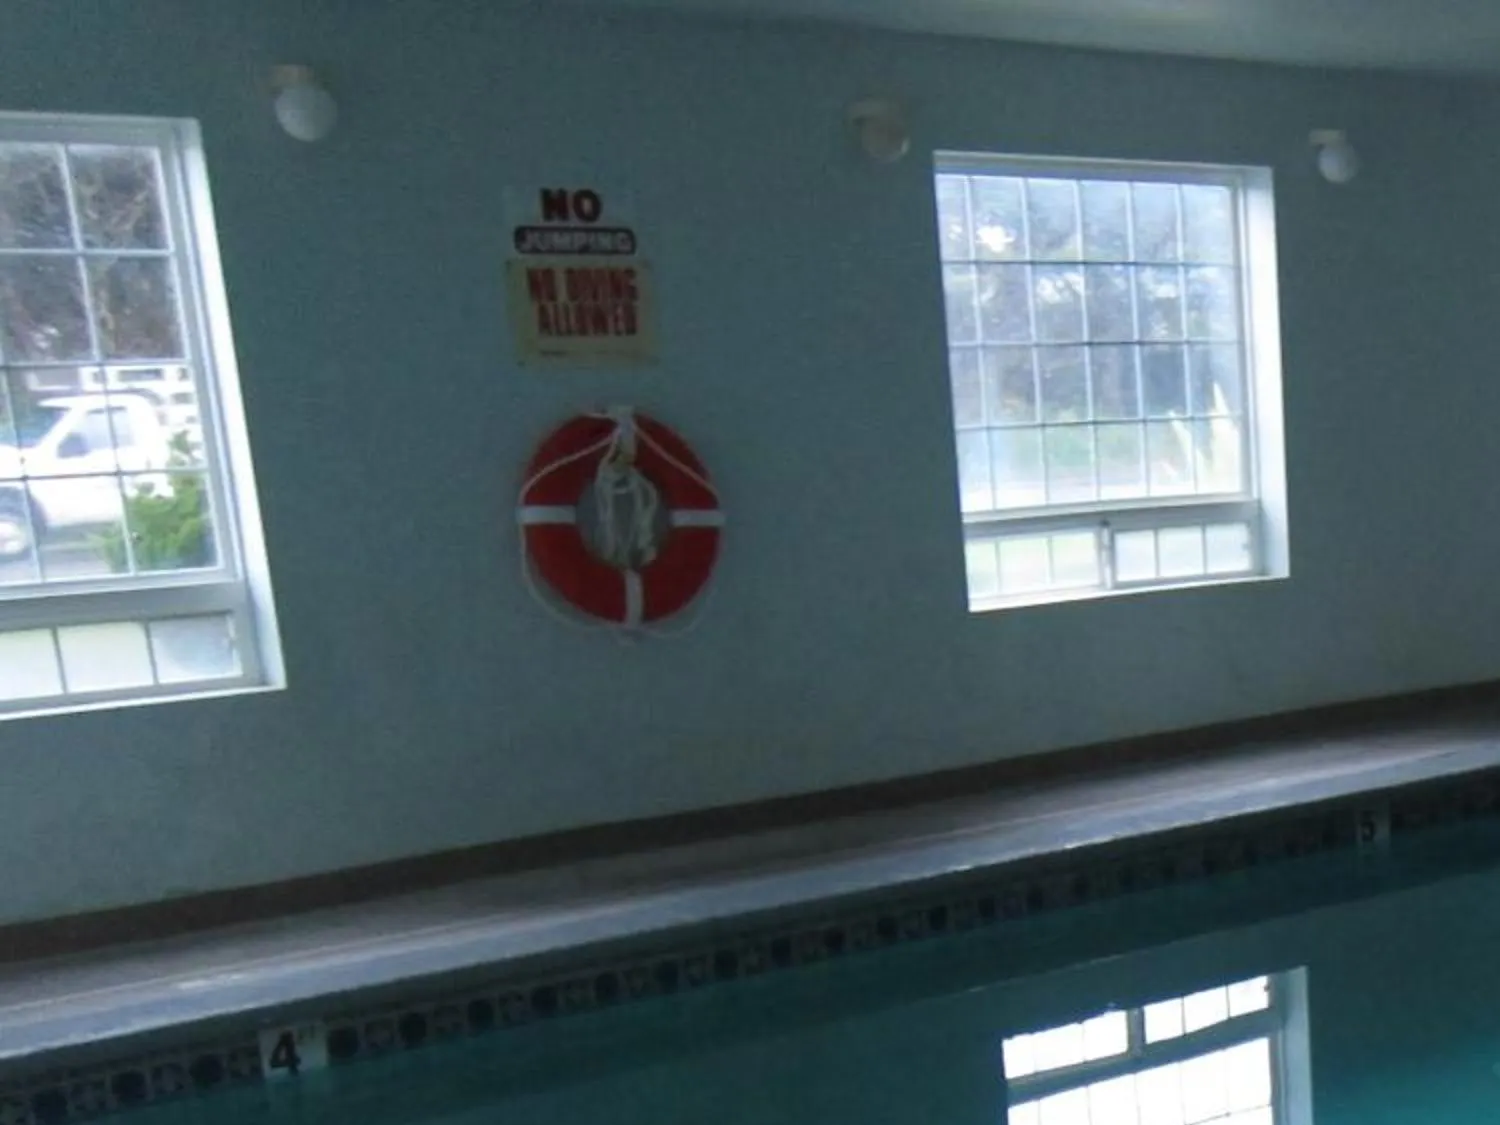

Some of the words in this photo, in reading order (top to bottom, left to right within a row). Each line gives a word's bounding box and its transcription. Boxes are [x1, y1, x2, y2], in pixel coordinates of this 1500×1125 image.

[540, 187, 603, 222] NO
[519, 229, 632, 251] JUMPING
[527, 266, 556, 302] NO
[565, 266, 639, 302] DIVING
[537, 302, 638, 336] ALLOWED
[270, 1030, 302, 1077] 4
